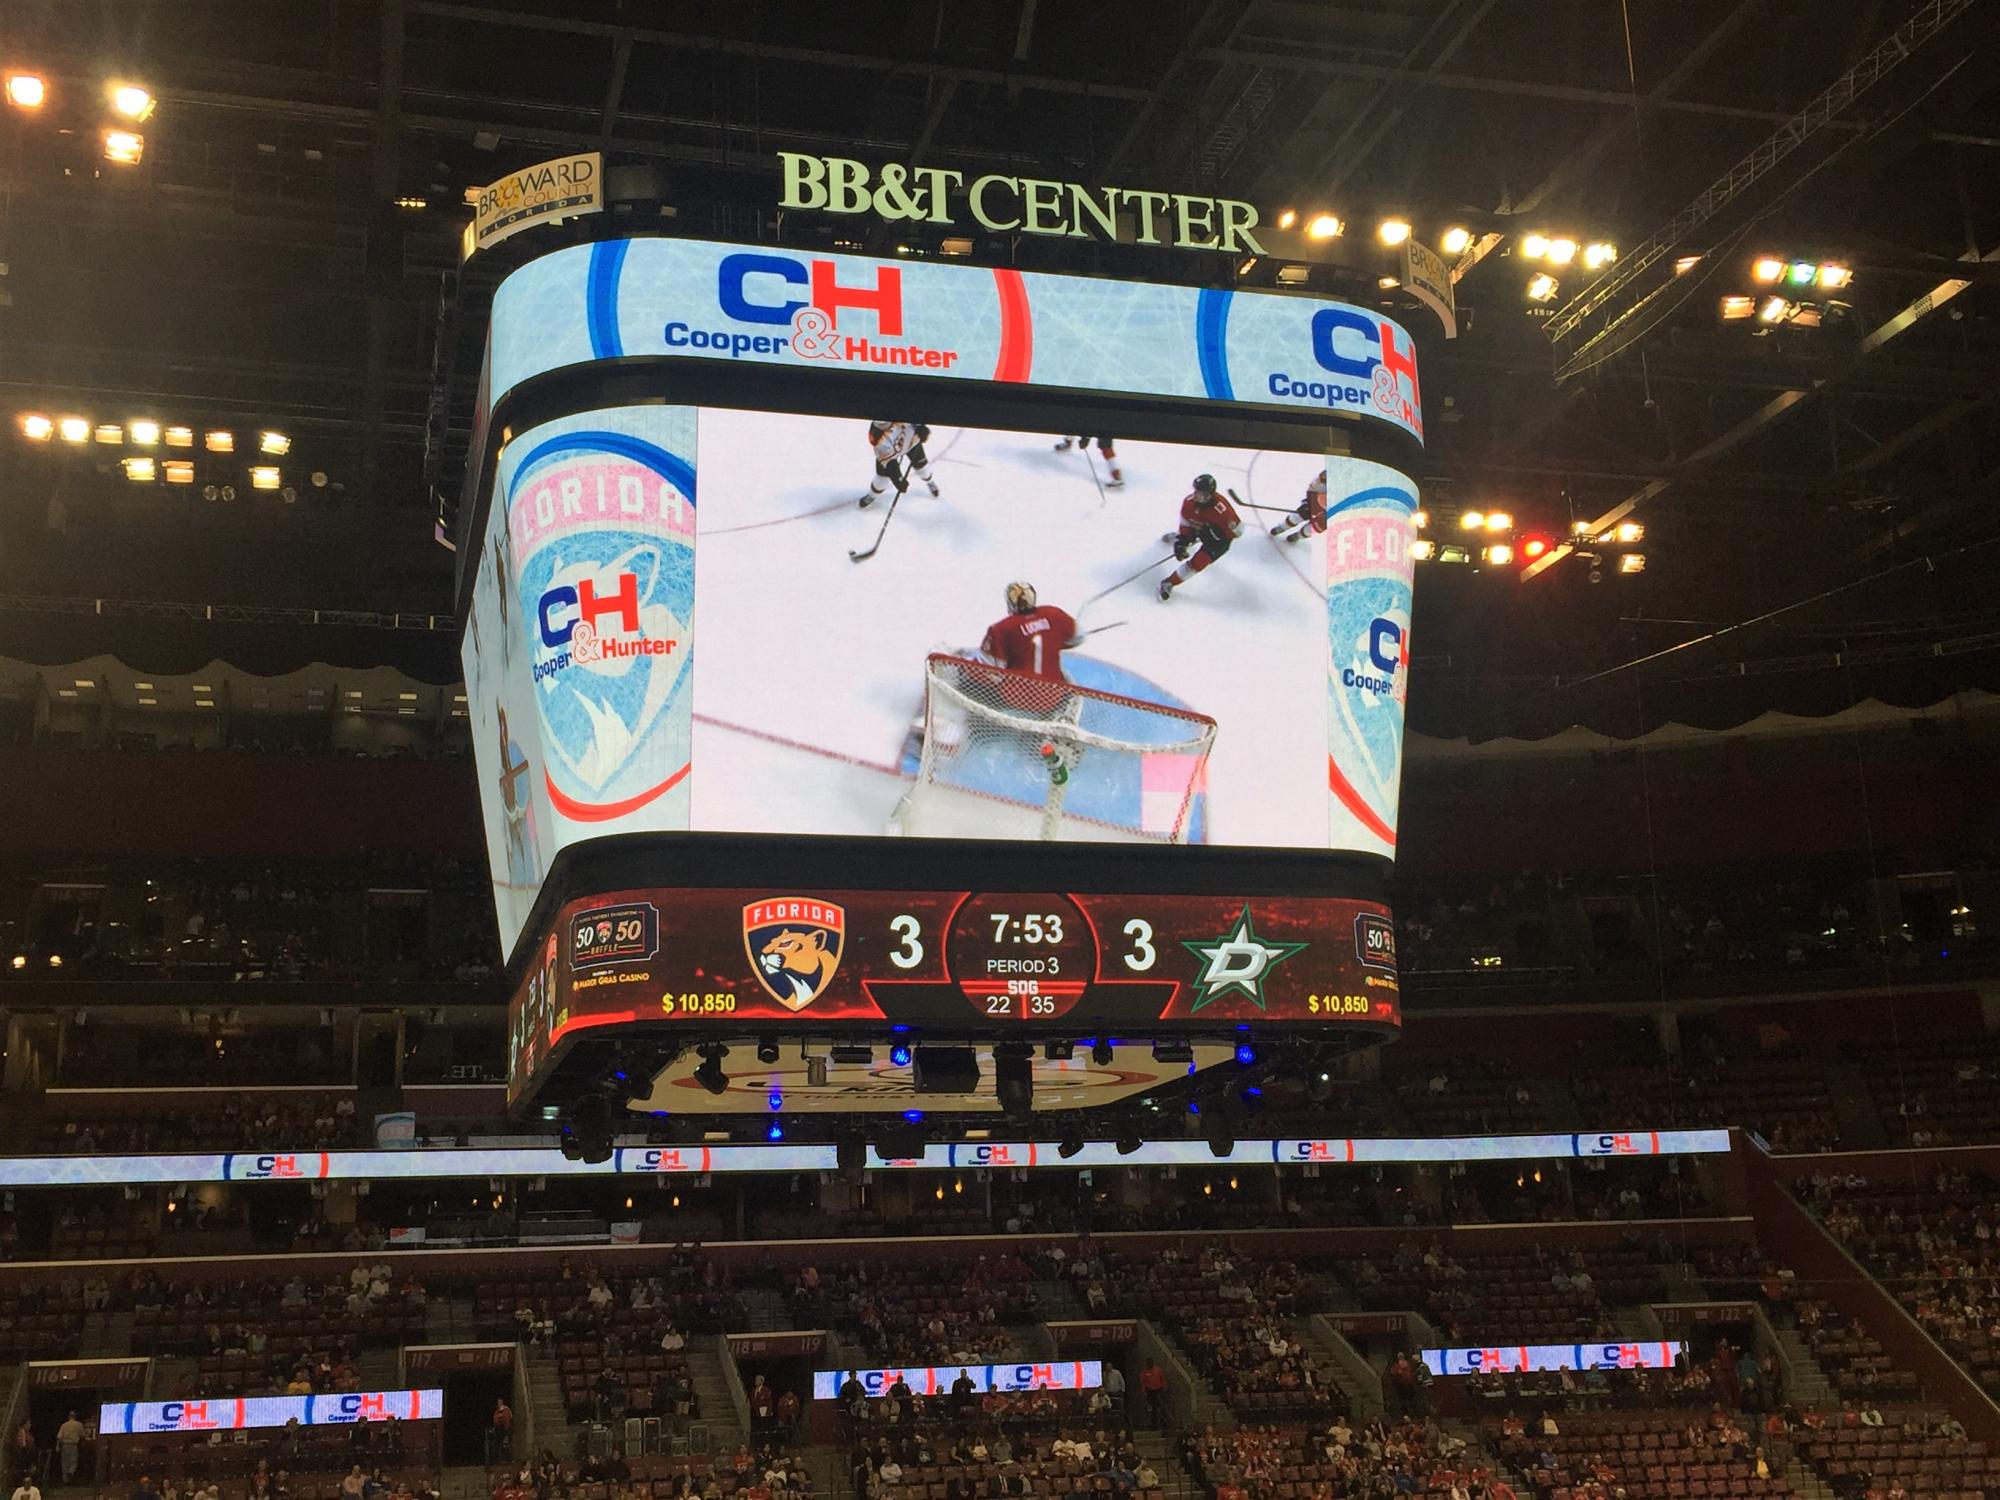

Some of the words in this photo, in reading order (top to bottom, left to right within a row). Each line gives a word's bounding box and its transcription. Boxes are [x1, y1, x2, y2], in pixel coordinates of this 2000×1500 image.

[480, 161, 593, 217] BROWARD
[523, 182, 592, 207] COUNTY
[776, 151, 963, 224] BB&T
[968, 174, 1269, 255] CENTER
[482, 197, 588, 236] FLORIDA
[718, 253, 903, 337] CH
[664, 322, 789, 357] Cooper
[792, 311, 841, 360] &
[845, 338, 958, 370] Hunter
[1311, 308, 1420, 406] CH
[1269, 373, 1371, 406] Cooper
[537, 573, 639, 648] CH
[533, 652, 572, 683] Cooper
[573, 624, 601, 663] &
[602, 637, 677, 659] Hunter
[1032, 635, 1043, 675] 1
[1343, 668, 1393, 696] Cooper
[752, 902, 836, 924] FLORIDA
[576, 926, 594, 948] 50
[616, 920, 642, 942] 50
[990, 914, 1064, 944] 7:53
[1367, 929, 1382, 948] 50
[889, 915, 923, 968] 3
[1123, 919, 1157, 971] 3
[987, 959, 1045, 974] PERIOD
[1048, 957, 1060, 975] 3
[1007, 980, 1039, 995] SOG
[662, 992, 675, 1014] $
[679, 993, 736, 1014] 10,850
[987, 996, 1010, 1014] 22
[1031, 996, 1055, 1014] 35
[1308, 994, 1320, 1013] $
[1322, 994, 1369, 1014] 10,850
[977, 1146, 1008, 1159] CH
[1298, 1142, 1327, 1155] CH
[1599, 1135, 1630, 1148] CH
[257, 1156, 295, 1171] CH
[645, 1150, 680, 1164] CH
[1467, 1349, 1501, 1365] CH
[1603, 1344, 1640, 1361] CH
[1016, 1365, 1053, 1382] CH
[162, 1401, 208, 1421] CH
[341, 1393, 385, 1413] CH
